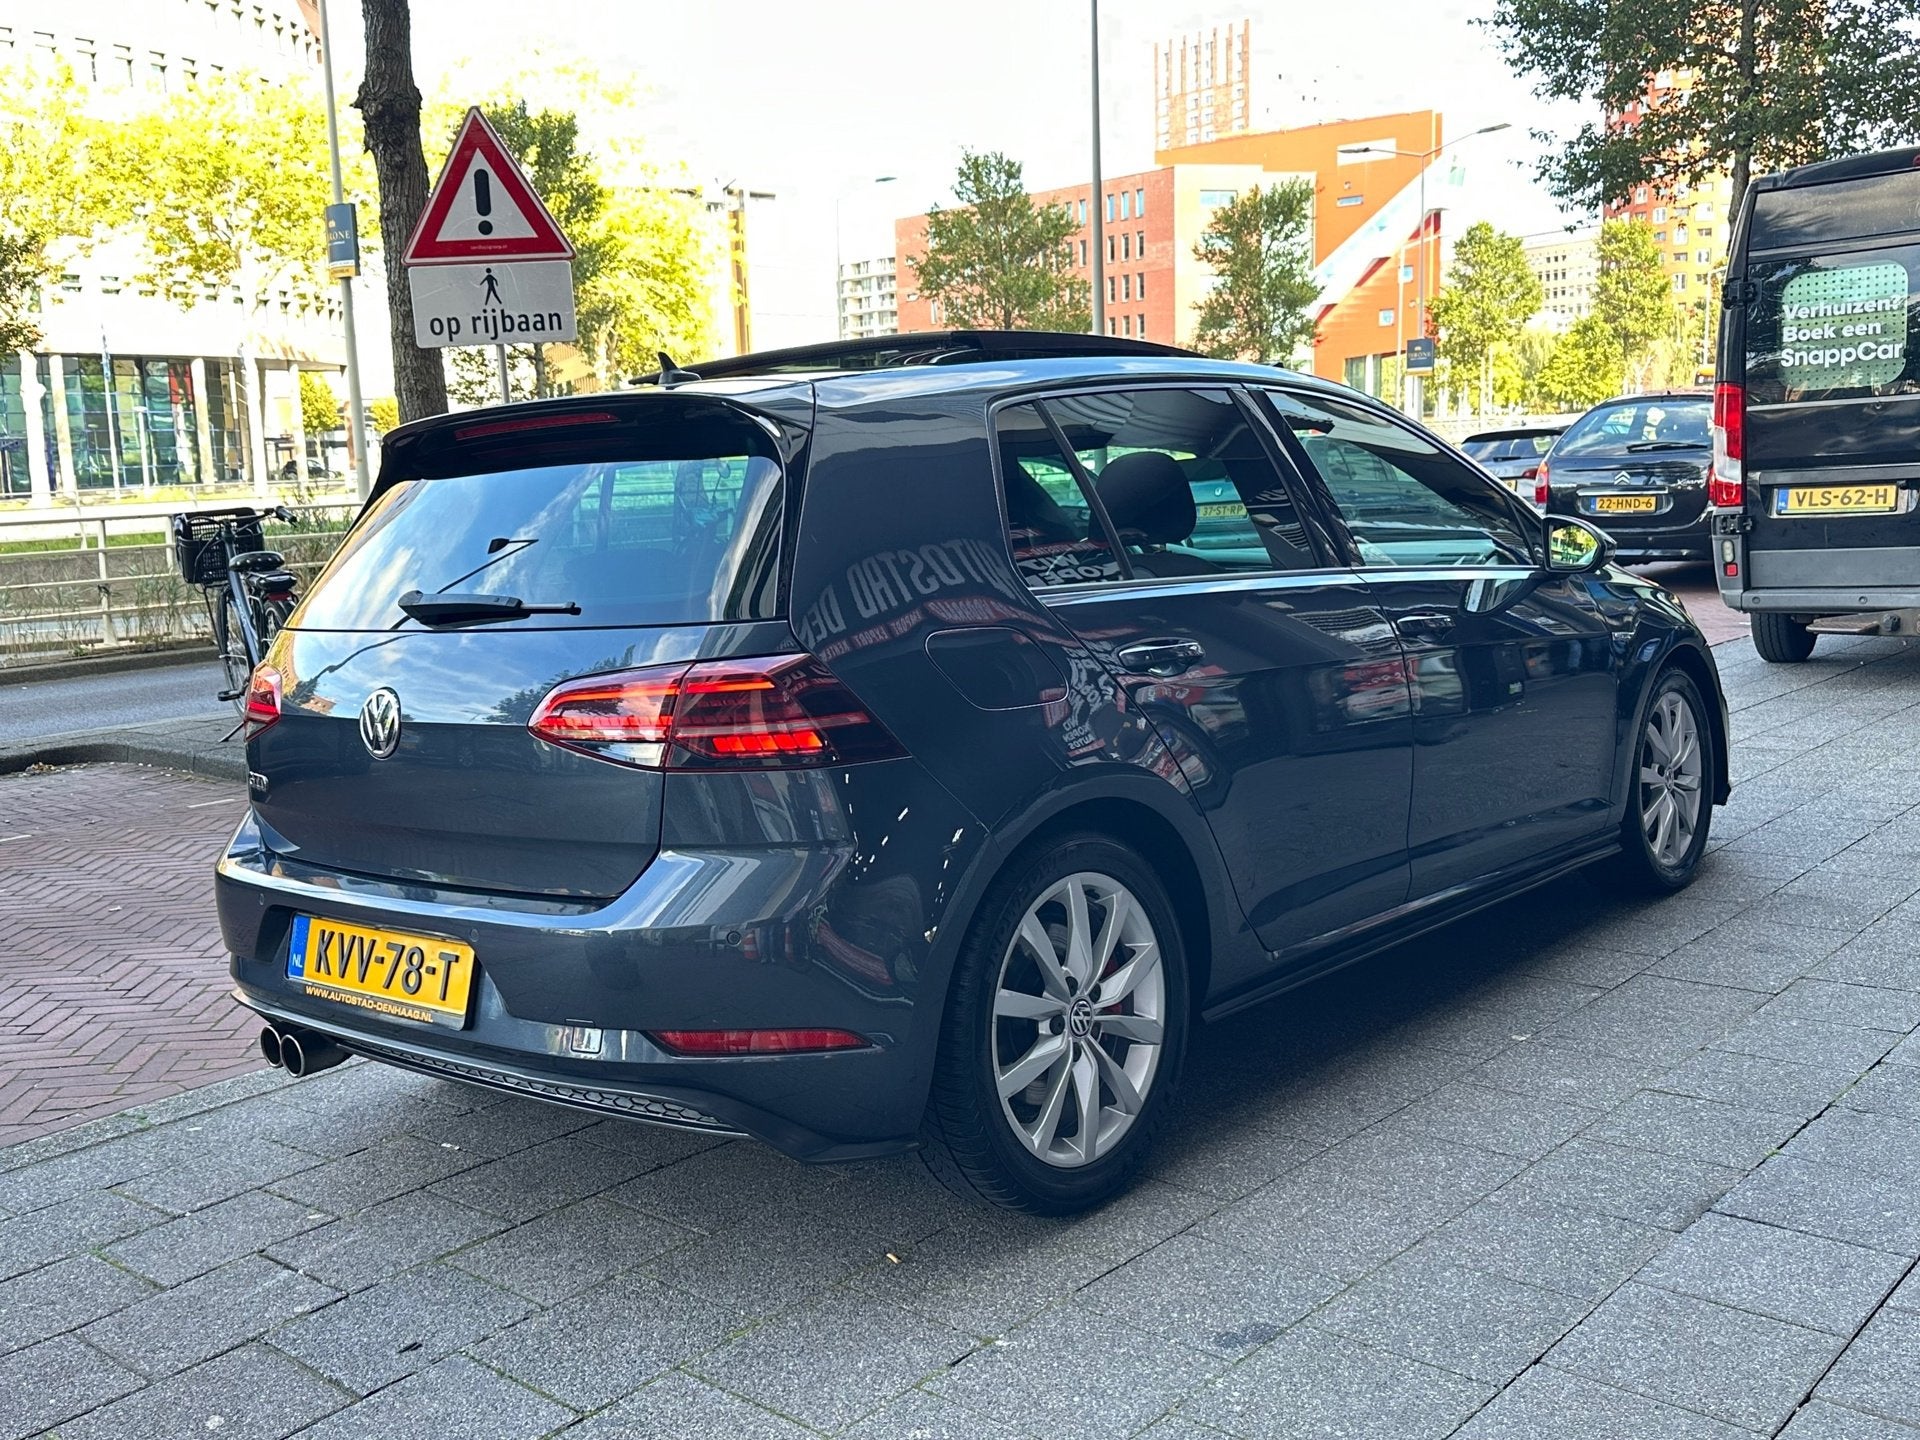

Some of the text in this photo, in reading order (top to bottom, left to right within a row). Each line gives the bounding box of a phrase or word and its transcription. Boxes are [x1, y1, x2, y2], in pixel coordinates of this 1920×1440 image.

[1782, 294, 1902, 320] Verhuizen?
[429, 308, 562, 342] op rijbaan
[1782, 322, 1881, 342] Boek een
[1780, 341, 1903, 368] SnappCar
[1598, 497, 1653, 510] 22-HND-6
[1795, 488, 1888, 507] VLS-62-H
[1202, 504, 1244, 517] 37-ST-RP
[291, 953, 304, 969] NL
[315, 928, 460, 1001] KVV-78-T
[305, 985, 434, 1023] WWW.AUTOSTAD-DENHAAG.NL
